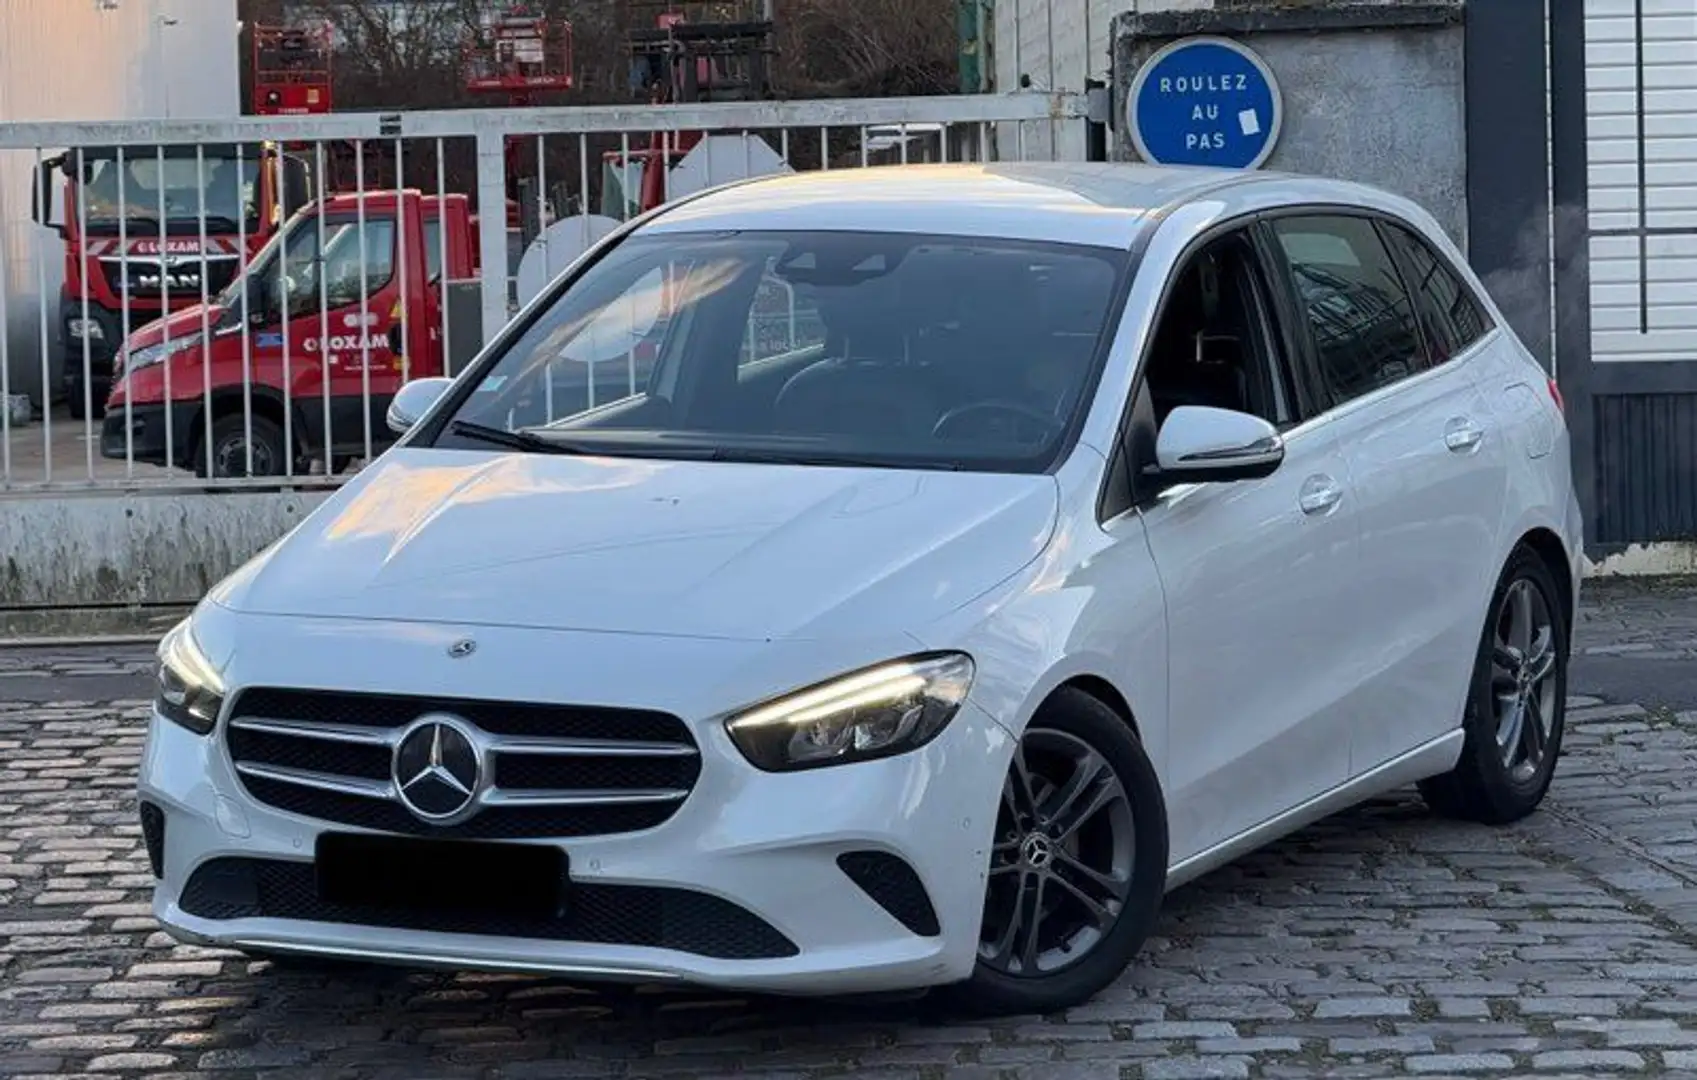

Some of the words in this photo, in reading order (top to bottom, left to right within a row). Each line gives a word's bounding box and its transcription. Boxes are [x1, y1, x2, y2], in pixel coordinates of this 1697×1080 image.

[1160, 74, 1247, 92] ROULEZ
[1192, 104, 1218, 120] AU
[1185, 132, 1225, 149] PAS
[139, 275, 199, 288] MAN
